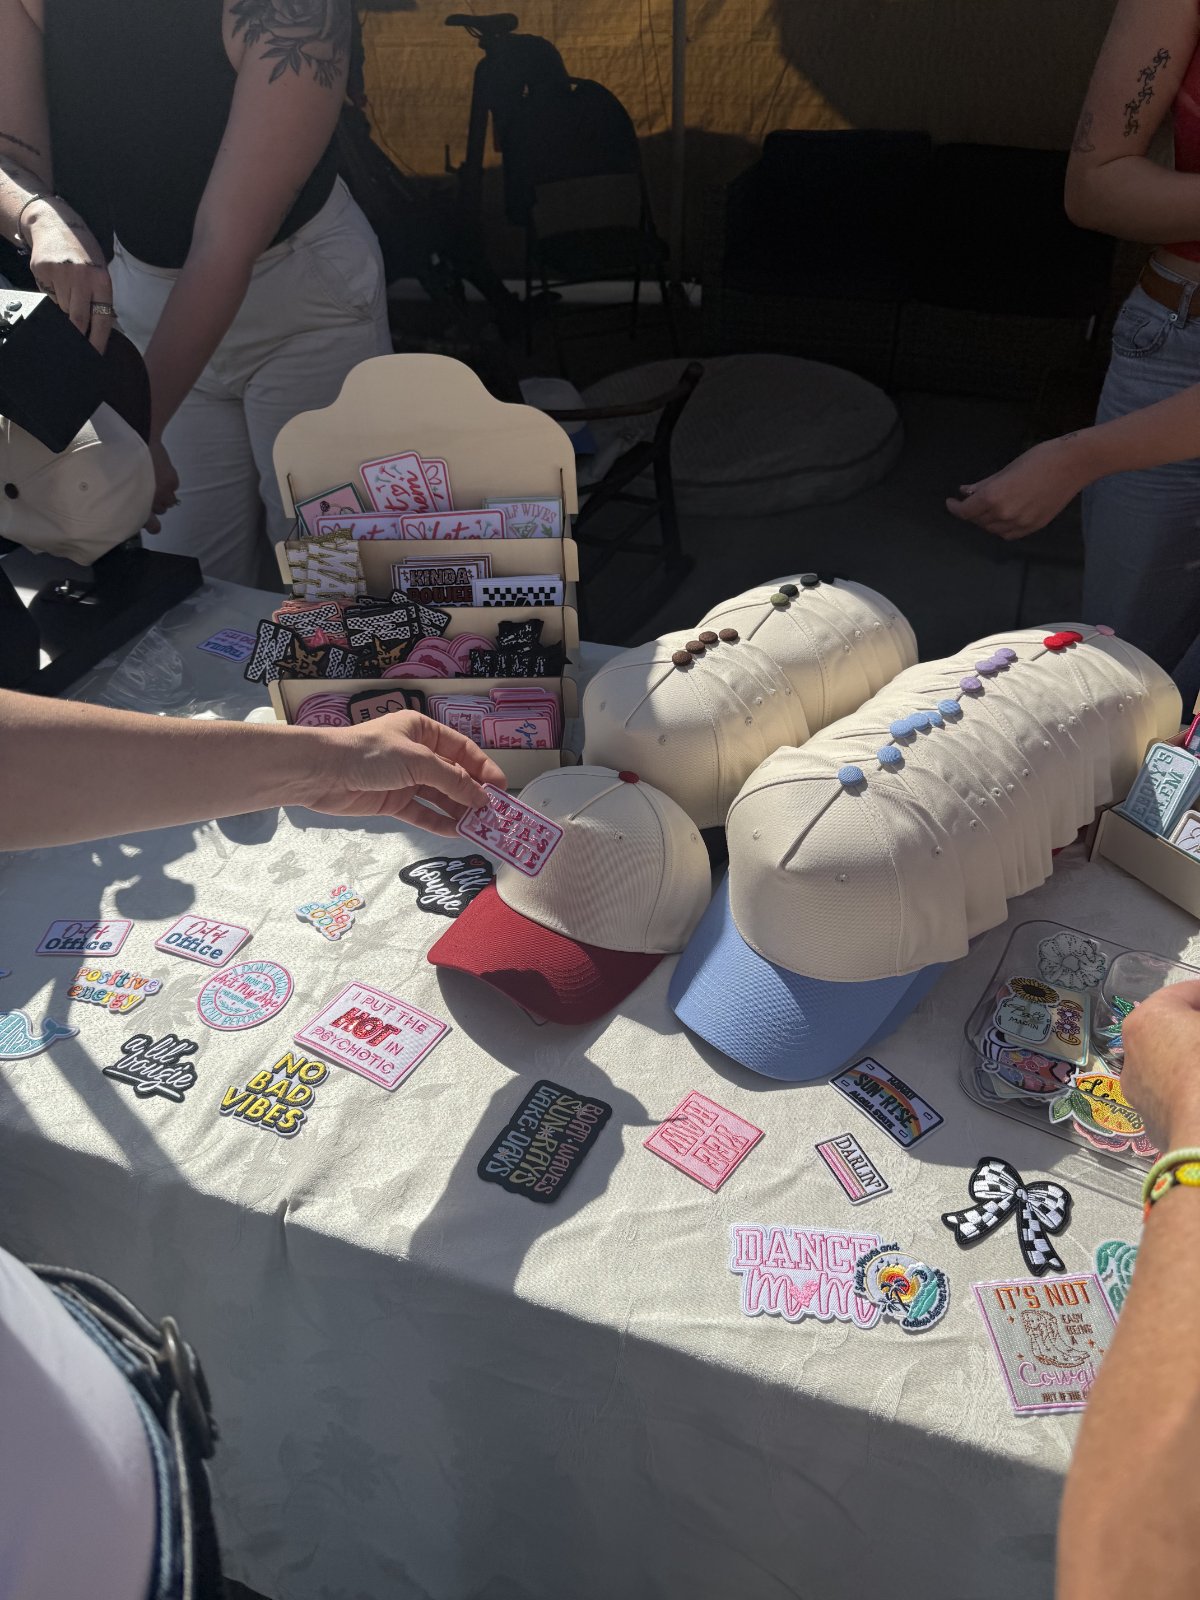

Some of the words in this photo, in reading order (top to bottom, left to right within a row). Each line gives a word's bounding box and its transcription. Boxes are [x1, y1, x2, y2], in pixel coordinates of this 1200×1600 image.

[521, 503, 557, 523] WIVES
[409, 567, 471, 587] KINDA
[408, 860, 463, 911] bougie
[45, 937, 113, 951] Office
[62, 922, 99, 939] Out
[165, 932, 223, 960] Office
[184, 920, 222, 940] Out
[73, 966, 160, 993] positive
[242, 962, 275, 975] DON'T
[67, 985, 142, 1010] energy
[203, 1007, 223, 1022] OLD
[352, 991, 362, 1001] I
[363, 996, 396, 1015] PUT
[398, 1011, 430, 1035] THE
[329, 1007, 402, 1047] HOT
[384, 1041, 405, 1056] IN
[274, 1052, 328, 1083] NO
[309, 1026, 395, 1074] PSYCHOTIC
[117, 1049, 193, 1091] bougie
[247, 1070, 313, 1105] BAD
[221, 1085, 305, 1132] VIBES
[517, 1085, 561, 1130] LAKE
[540, 1095, 574, 1141] SUN
[849, 1090, 875, 1111] ALOHA
[872, 1109, 896, 1130] STATE
[853, 1073, 919, 1129] SUN-RISE
[485, 1130, 532, 1178] DAYS
[508, 1133, 556, 1188] RAYS
[534, 1142, 580, 1196] WAVES
[835, 1136, 882, 1188] DARLIN'
[735, 1228, 878, 1273] DANCE
[994, 1285, 1041, 1311] IT'S
[1044, 1281, 1091, 1308] NOT
[1061, 1312, 1084, 1324] EASY
[1065, 1324, 1094, 1335] BEING
[1071, 1336, 1078, 1345] A
